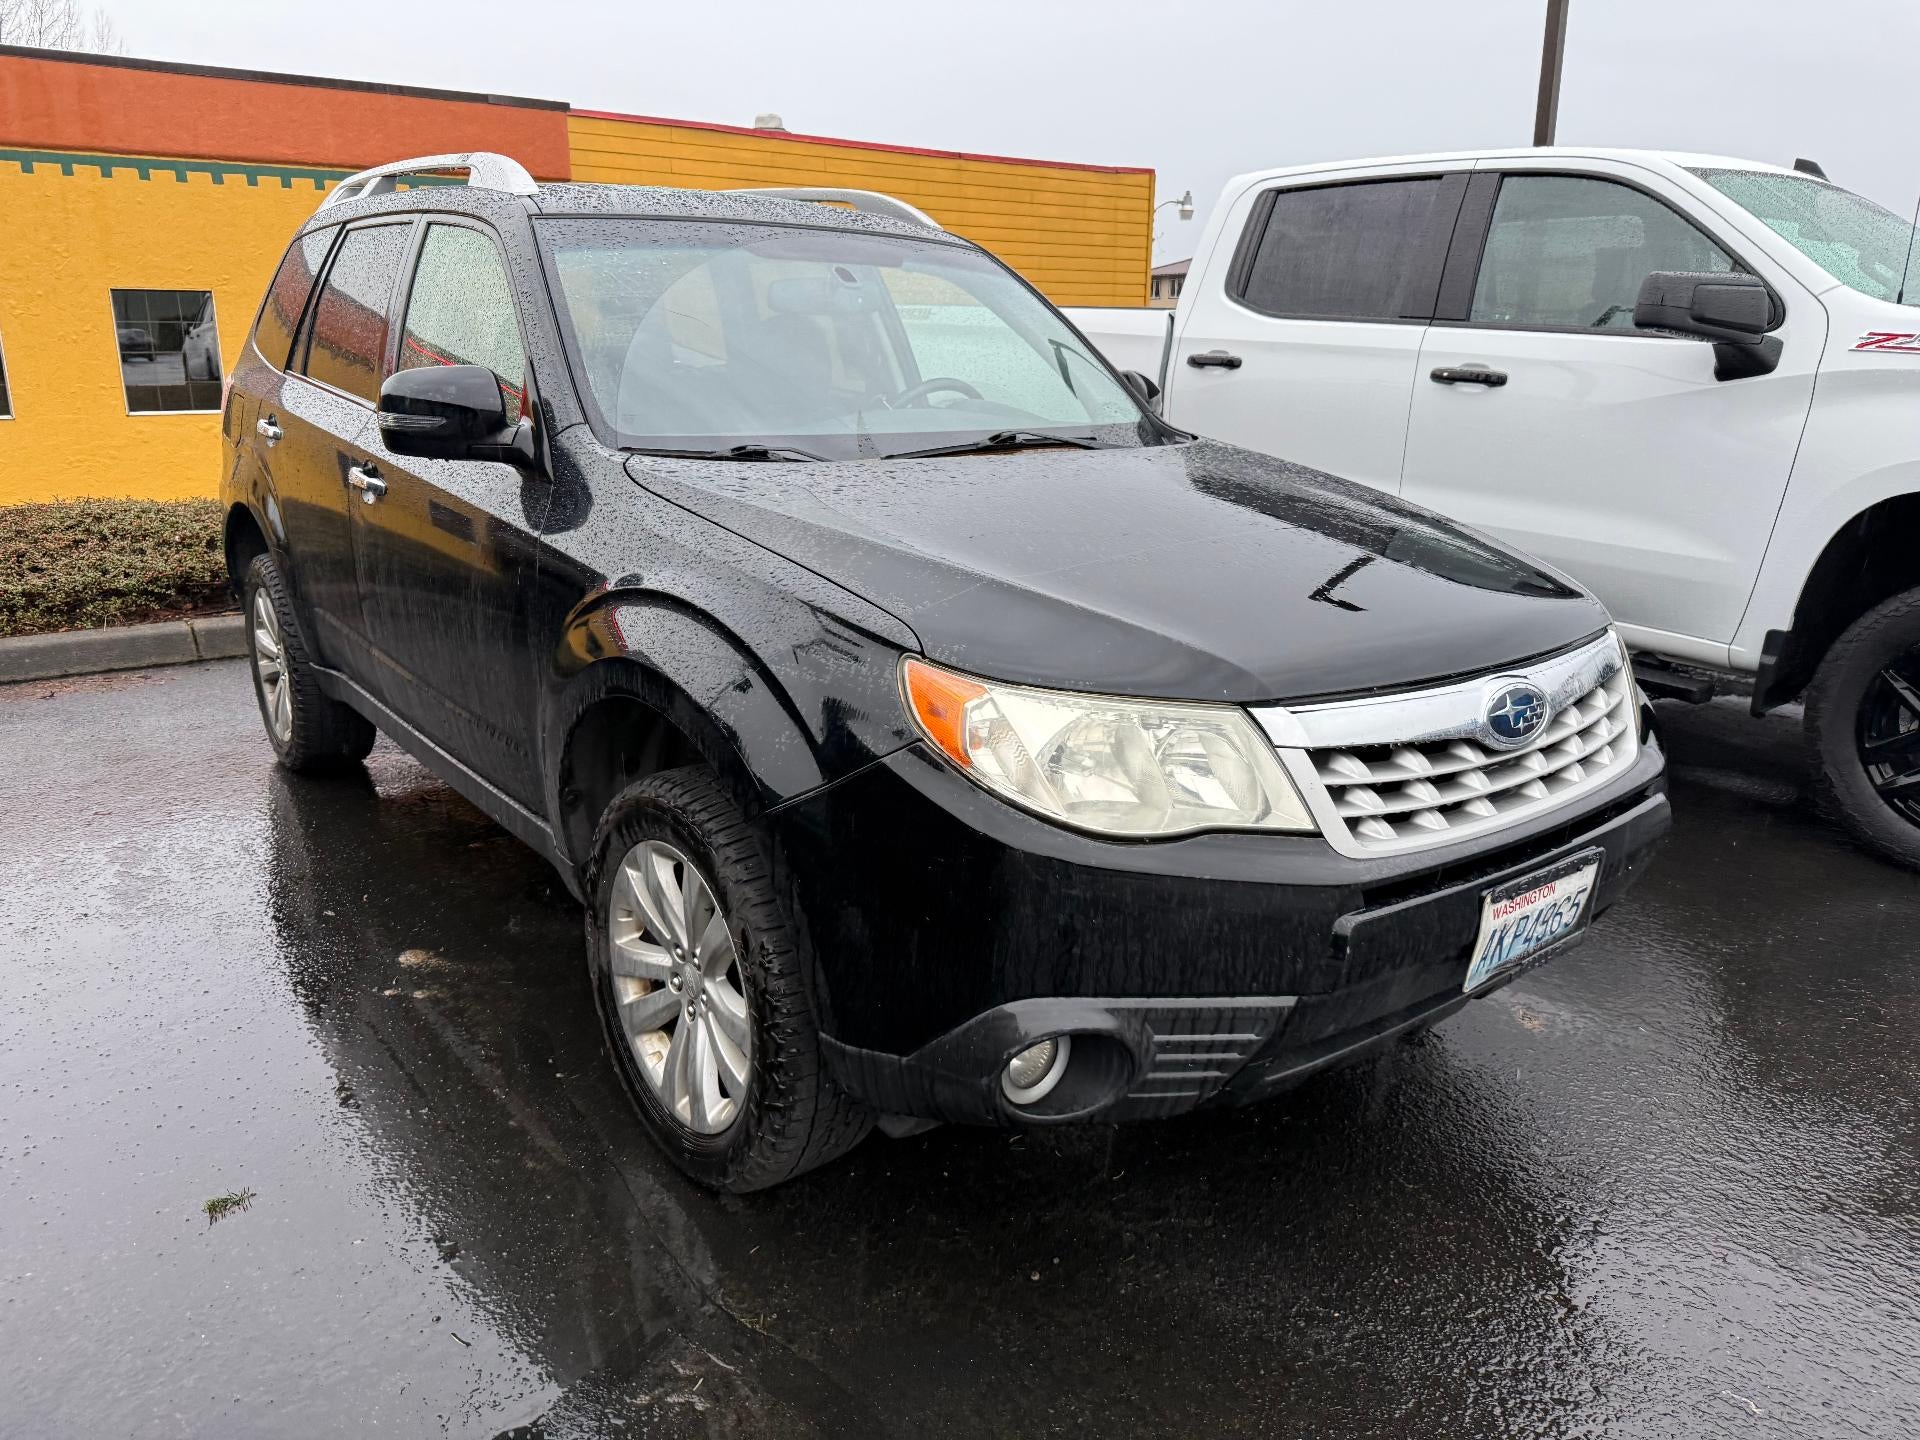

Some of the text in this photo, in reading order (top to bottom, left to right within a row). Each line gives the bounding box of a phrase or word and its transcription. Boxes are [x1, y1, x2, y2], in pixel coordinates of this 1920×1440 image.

[1853, 331, 1920, 352] Z
[1491, 882, 1556, 920] WASHINGTON
[1475, 886, 1588, 974] AKP4965
